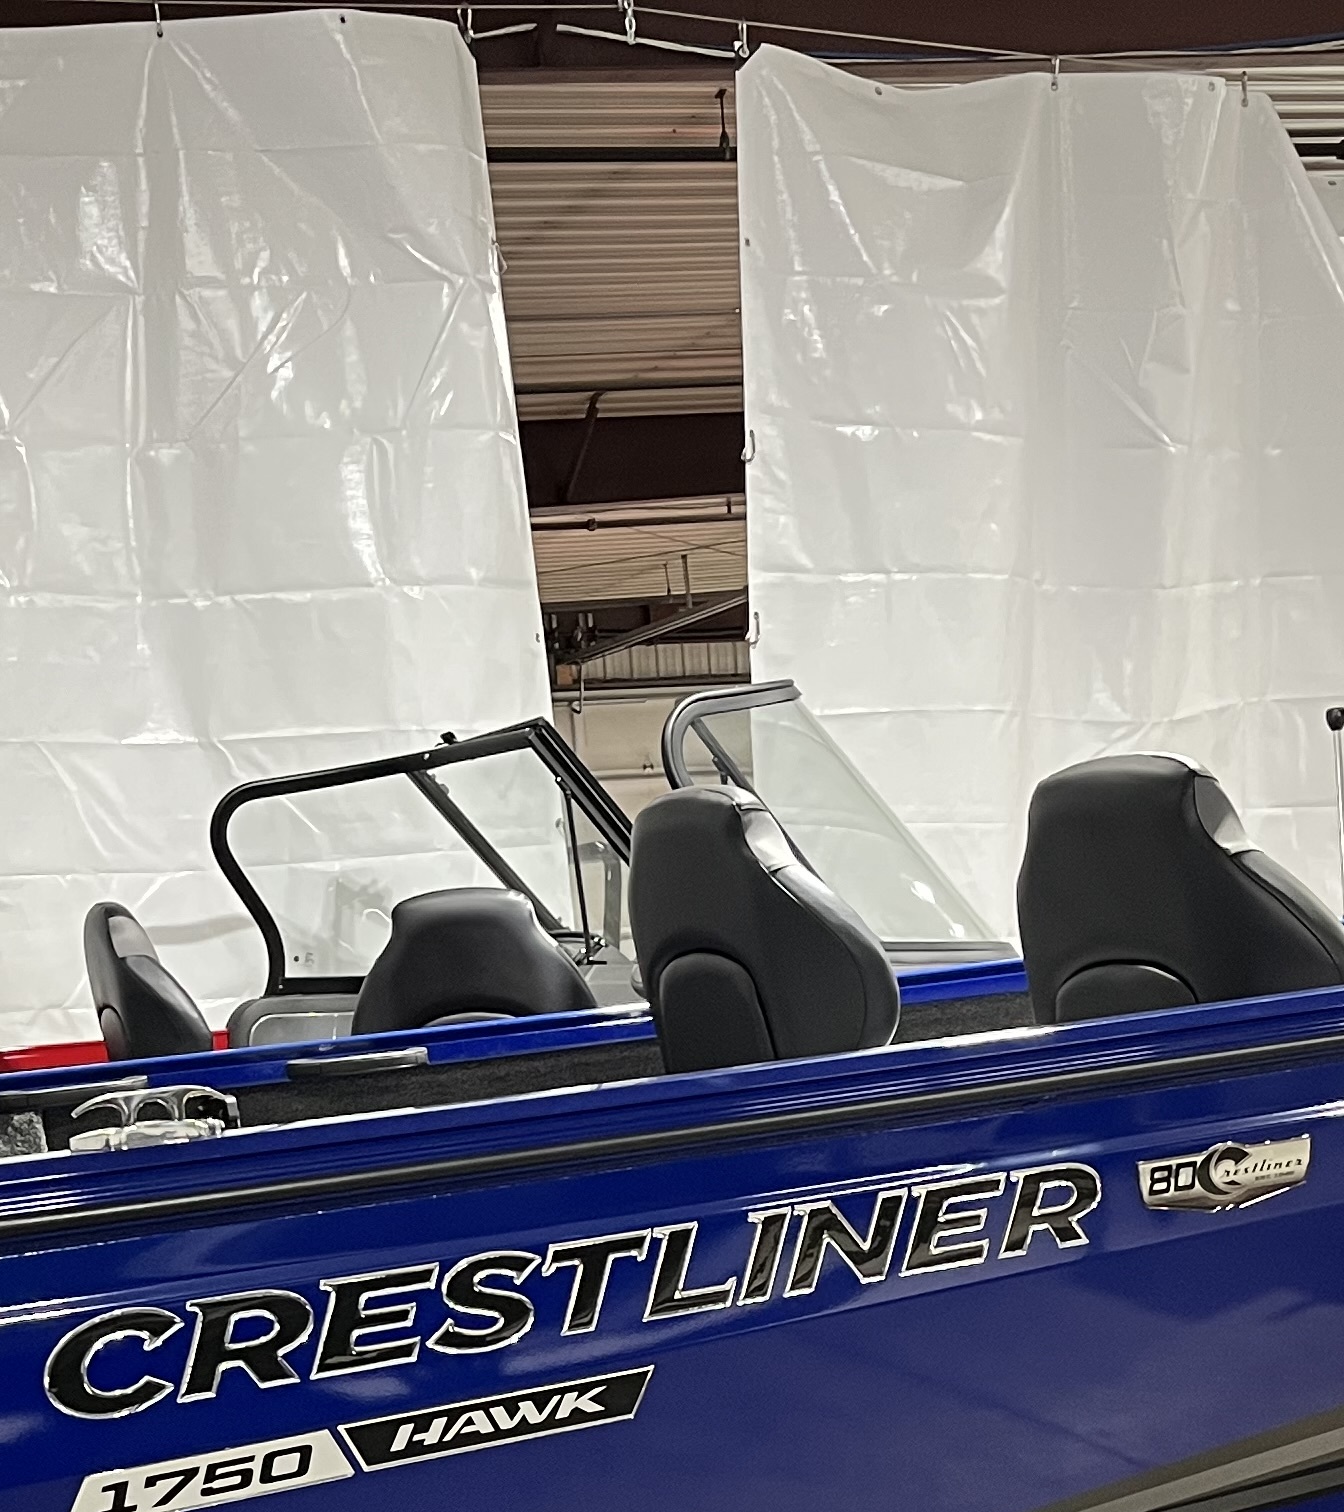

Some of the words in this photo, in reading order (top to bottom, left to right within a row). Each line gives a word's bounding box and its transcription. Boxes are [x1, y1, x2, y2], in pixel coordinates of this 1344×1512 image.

[1148, 1160, 1197, 1196] 80
[43, 1162, 1103, 1420] CRESTLINER
[389, 1385, 607, 1452] HAWK
